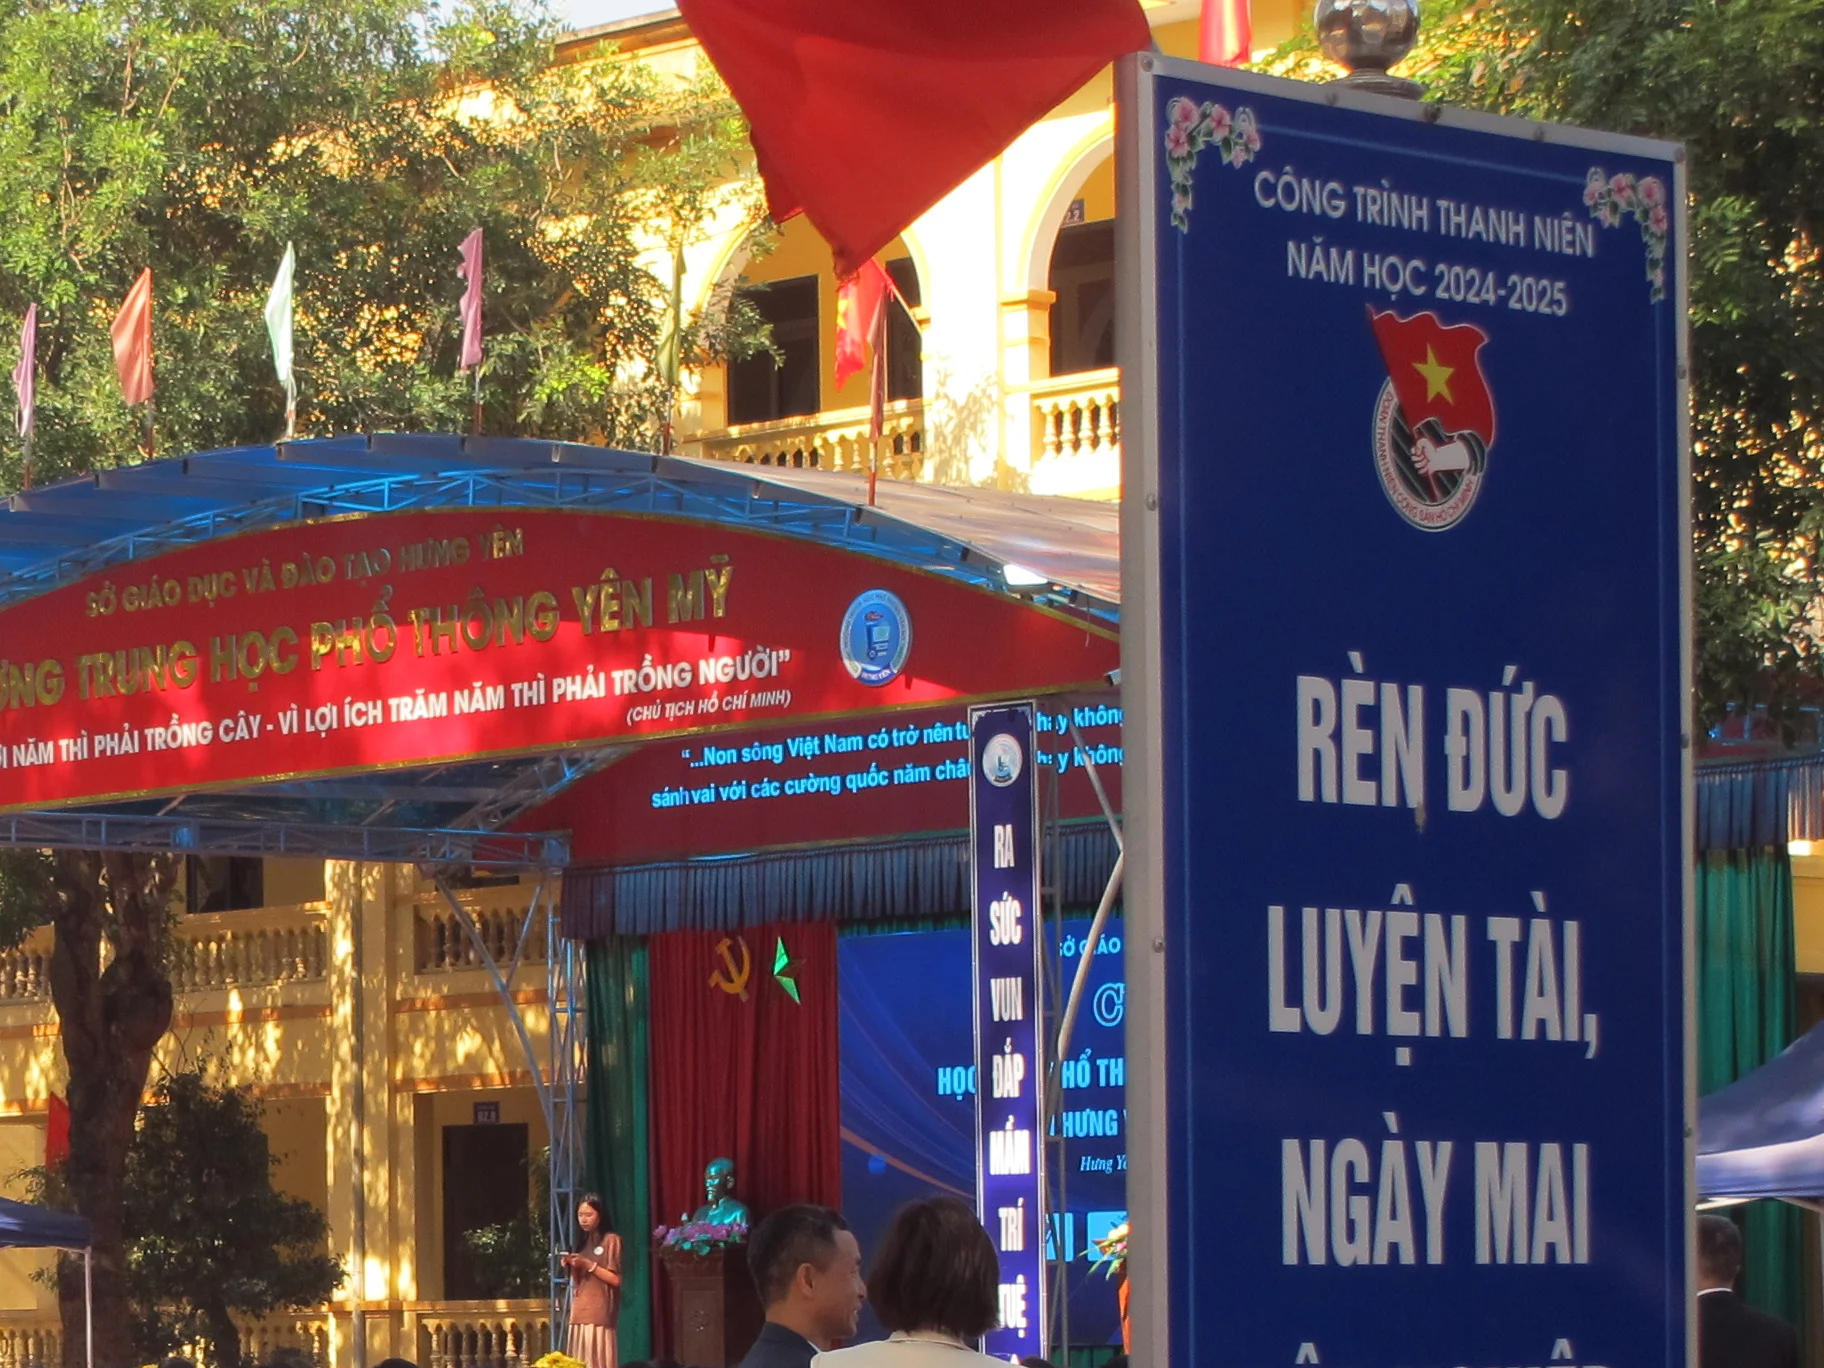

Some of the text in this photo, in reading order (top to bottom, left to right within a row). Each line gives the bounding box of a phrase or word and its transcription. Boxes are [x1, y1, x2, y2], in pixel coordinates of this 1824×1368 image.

[1254, 166, 1595, 259] CÔNG TRÌNH THANH NIÊN
[1287, 235, 1568, 317] NĂM HỌC 2024-2025
[86, 524, 525, 618] SỞ GIÁO DỤC VÀ ĐÀO TẠO HƯNG YÊN
[74, 641, 199, 700] TRUNG
[210, 626, 299, 692] HỌC
[310, 585, 398, 671] PHỔ
[408, 586, 561, 658] THÔNG
[571, 568, 653, 636] YÊN
[668, 554, 734, 624] MỸ
[12, 738, 54, 767] NĂM
[59, 731, 89, 762] THÌ
[94, 723, 140, 759] PHẢI
[144, 714, 214, 752] TRỒNG
[218, 711, 262, 744] CÂY
[278, 703, 298, 736] VÌ
[305, 702, 338, 739] LỢI
[344, 696, 383, 727] ÍCH
[388, 688, 448, 722] TRĂM
[453, 681, 505, 715] NĂM
[511, 671, 545, 709] THÌ
[552, 664, 606, 703] PHẢI
[612, 653, 692, 696] TRỒNG
[626, 688, 792, 726] (CHỦ TỊCH HỒ CHÍ MINH)
[741, 741, 784, 765] sông
[787, 736, 821, 760] Việt
[824, 733, 863, 754] Nam
[867, 727, 890, 749] có
[891, 723, 919, 747] trở
[922, 720, 954, 744] nên
[1073, 704, 1124, 728] khôn
[1296, 650, 1569, 820] RÈN ĐỨC
[651, 786, 689, 809] sánh
[691, 783, 716, 804] vai
[719, 779, 748, 801] với
[750, 776, 781, 799] các
[784, 773, 841, 797] cường
[845, 763, 889, 793] quốc
[893, 761, 930, 785] năm
[993, 824, 1015, 869] RA
[989, 891, 1022, 946] SỨC
[990, 977, 1024, 1022] VUN
[1267, 883, 1599, 1066] LUYỆN TÀI,
[992, 1037, 1025, 1099] ĐẮP
[1096, 1057, 1125, 1087] TH
[1062, 1108, 1118, 1138] HƯNG
[1080, 1155, 1113, 1174] Hưng
[1281, 1111, 1590, 1267] NGÀY MAI
[998, 1197, 1024, 1252] TRÍ
